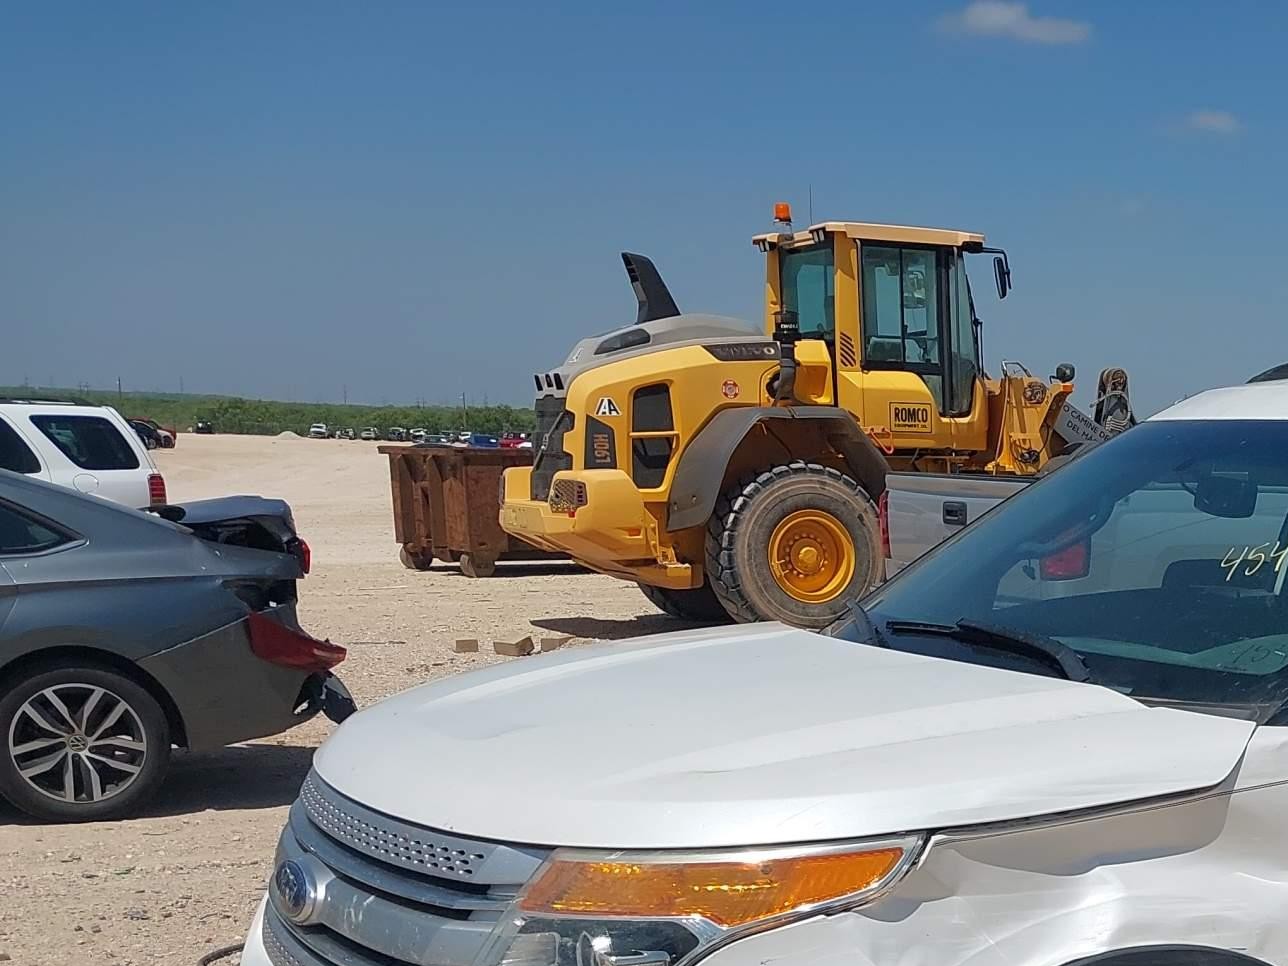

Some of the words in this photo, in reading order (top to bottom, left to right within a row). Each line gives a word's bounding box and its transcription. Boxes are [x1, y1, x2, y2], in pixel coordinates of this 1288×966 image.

[894, 406, 928, 423] ROMCO
[1070, 410, 1099, 434] CAMINE
[1066, 420, 1081, 434] DEL
